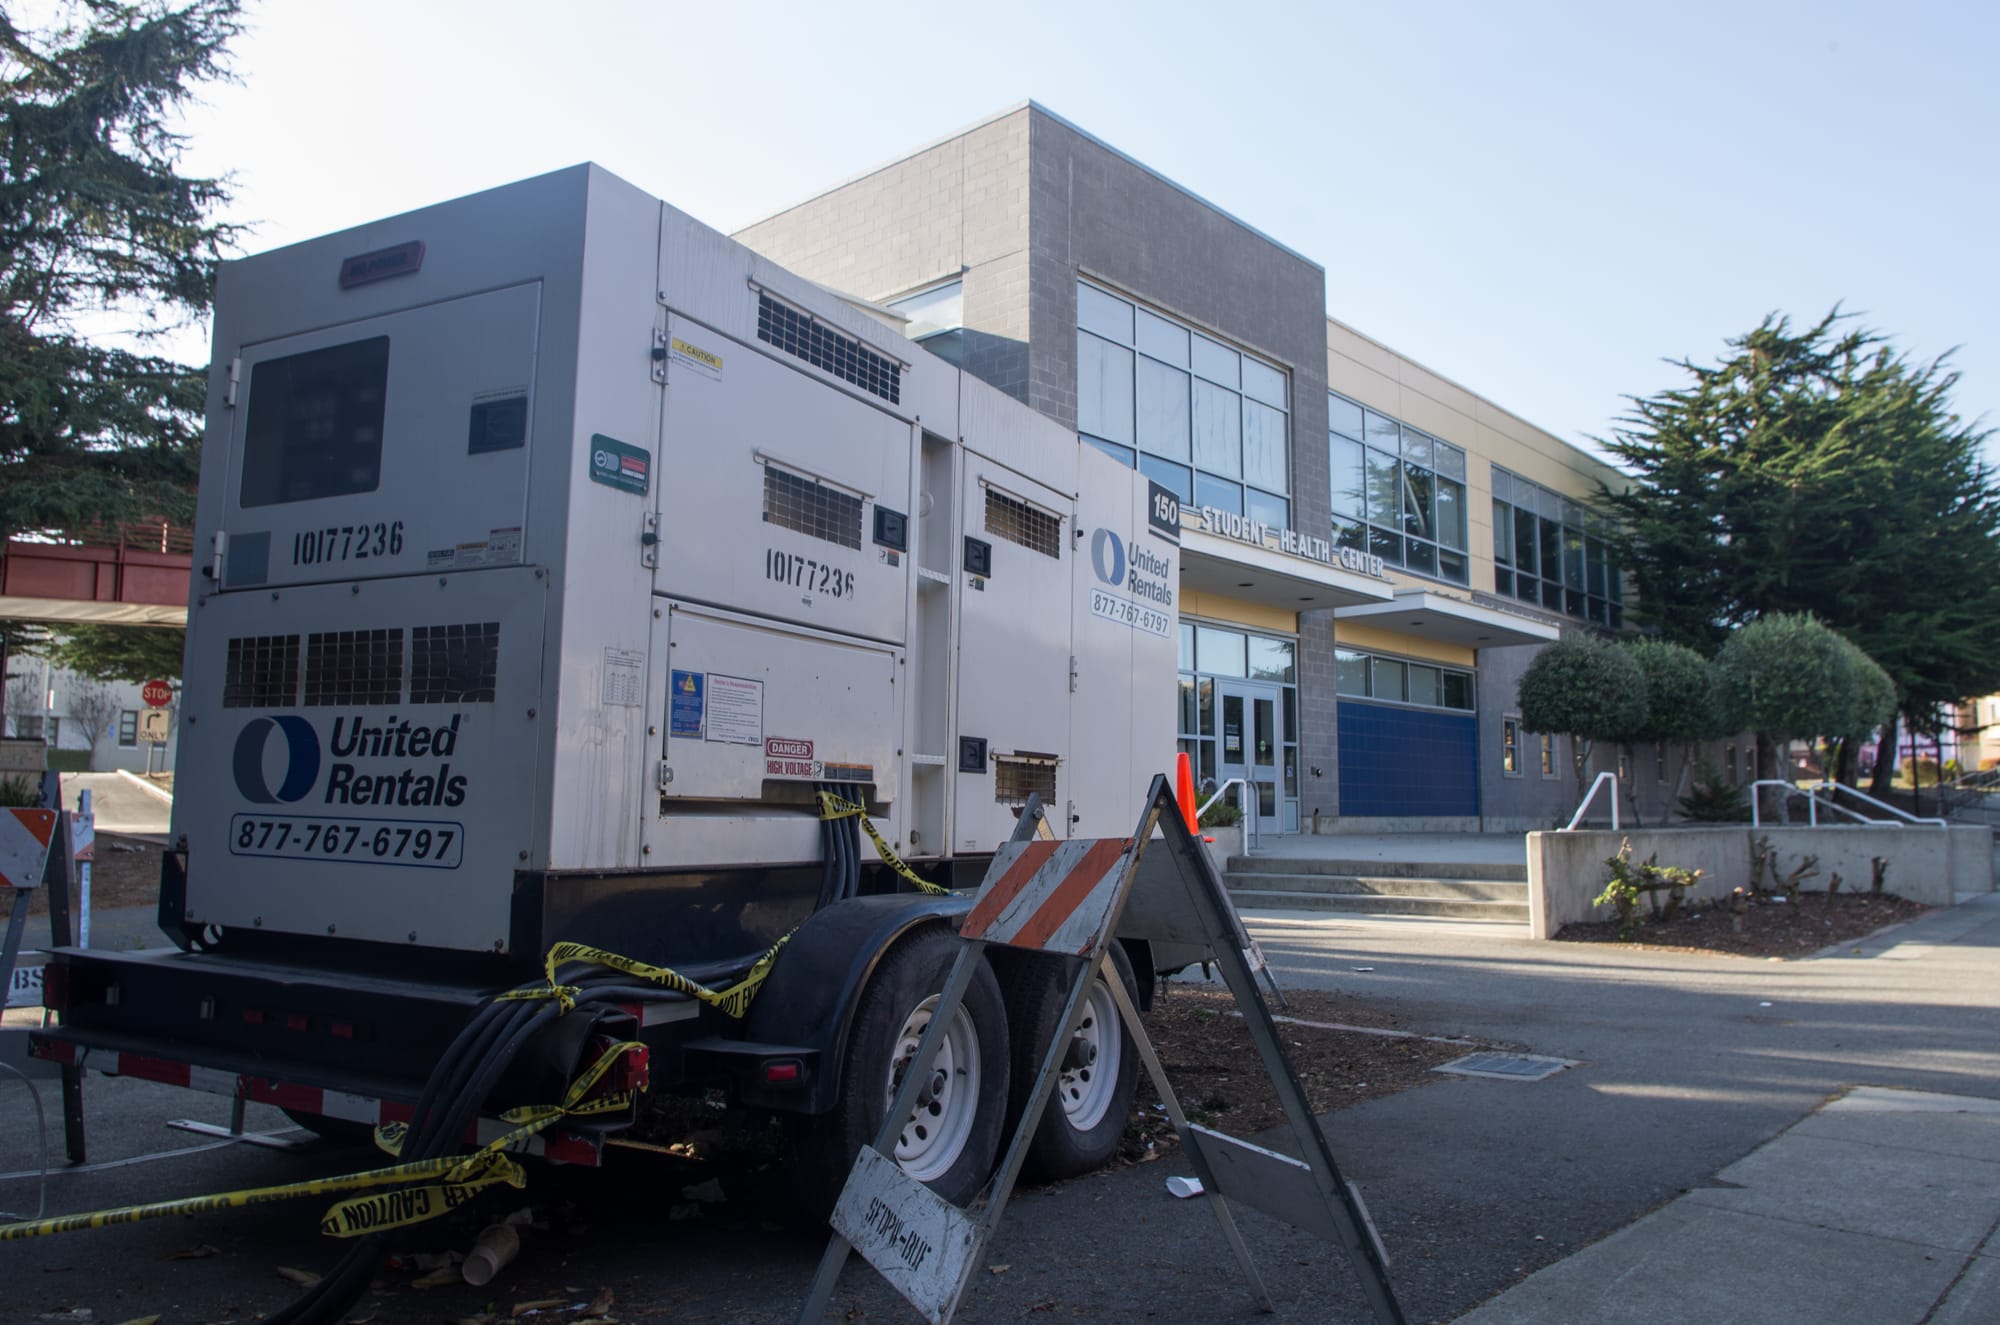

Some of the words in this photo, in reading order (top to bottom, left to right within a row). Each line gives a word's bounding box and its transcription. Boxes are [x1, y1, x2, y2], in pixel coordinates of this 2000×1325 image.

[687, 346, 716, 364] CAUTION
[1154, 492, 1177, 525] 150
[293, 521, 404, 566] 10177236
[1129, 542, 1169, 579] United
[1200, 506, 1269, 545] STUDENT
[1280, 531, 1331, 564] HEALTH
[1340, 546, 1384, 577] CENTER
[1128, 569, 1172, 607] Rentals
[1094, 593, 1168, 633] 877-767-6797
[144, 686, 172, 701] STOP
[140, 731, 166, 740] ONLY
[331, 713, 461, 757] United
[772, 743, 808, 755] DANGER
[325, 763, 468, 807] Rentals
[766, 760, 783, 775] HIGH
[785, 760, 813, 777] VOLTAGE
[238, 821, 454, 861] 877-767-6797
[343, 1189, 430, 1230] CAUTION
